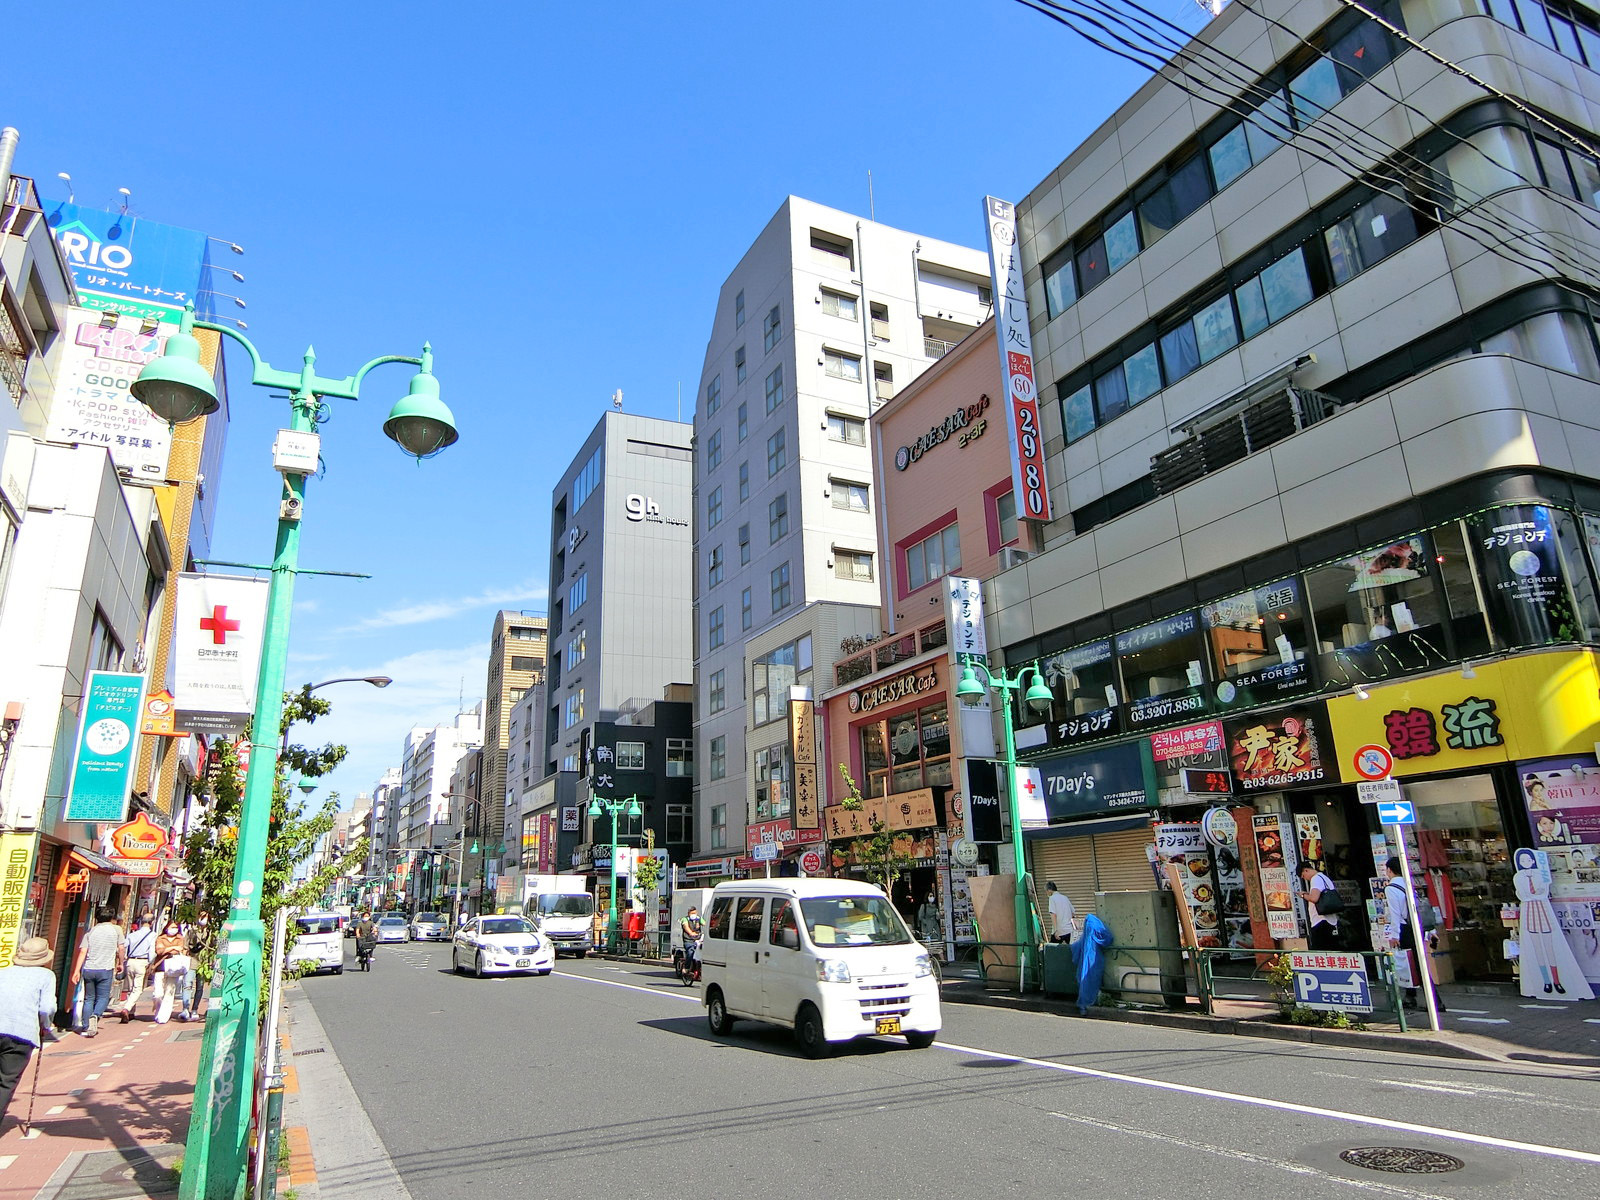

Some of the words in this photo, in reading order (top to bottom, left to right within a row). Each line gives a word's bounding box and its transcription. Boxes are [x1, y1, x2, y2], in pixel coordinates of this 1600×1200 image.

[994, 201, 1010, 217] 5F
[61, 231, 133, 269] RIO
[1000, 252, 1029, 349] ほぐし処
[81, 326, 167, 356] K-PO
[85, 373, 130, 390] GOO
[1013, 376, 1031, 395] 60
[72, 399, 118, 412] K-POP
[78, 410, 124, 422] Fashion
[67, 428, 111, 443] アイドル
[115, 435, 153, 449] 写真集
[910, 408, 969, 463] CAESAR
[958, 420, 987, 449] 2-3F
[1019, 408, 1043, 515] 2,980
[1497, 580, 1518, 590] SEA
[1521, 576, 1558, 585] FOREST
[1236, 675, 1258, 687] SEA
[1261, 663, 1306, 681] FOREST
[861, 675, 918, 712] CAESAR
[917, 671, 936, 691] Cafe
[1058, 710, 1114, 739] テジョンデ
[1383, 696, 1504, 760] 韓流
[1047, 771, 1095, 796] 7Day's
[1252, 768, 1324, 788] 03-6265-9315
[972, 795, 998, 807] 7Day's
[760, 825, 775, 844] Feel
[775, 823, 796, 842] Korea
[1293, 955, 1361, 969] 路上駐車禁止
[1298, 972, 1319, 1001] P
[1321, 993, 1364, 1005] ここ左折
